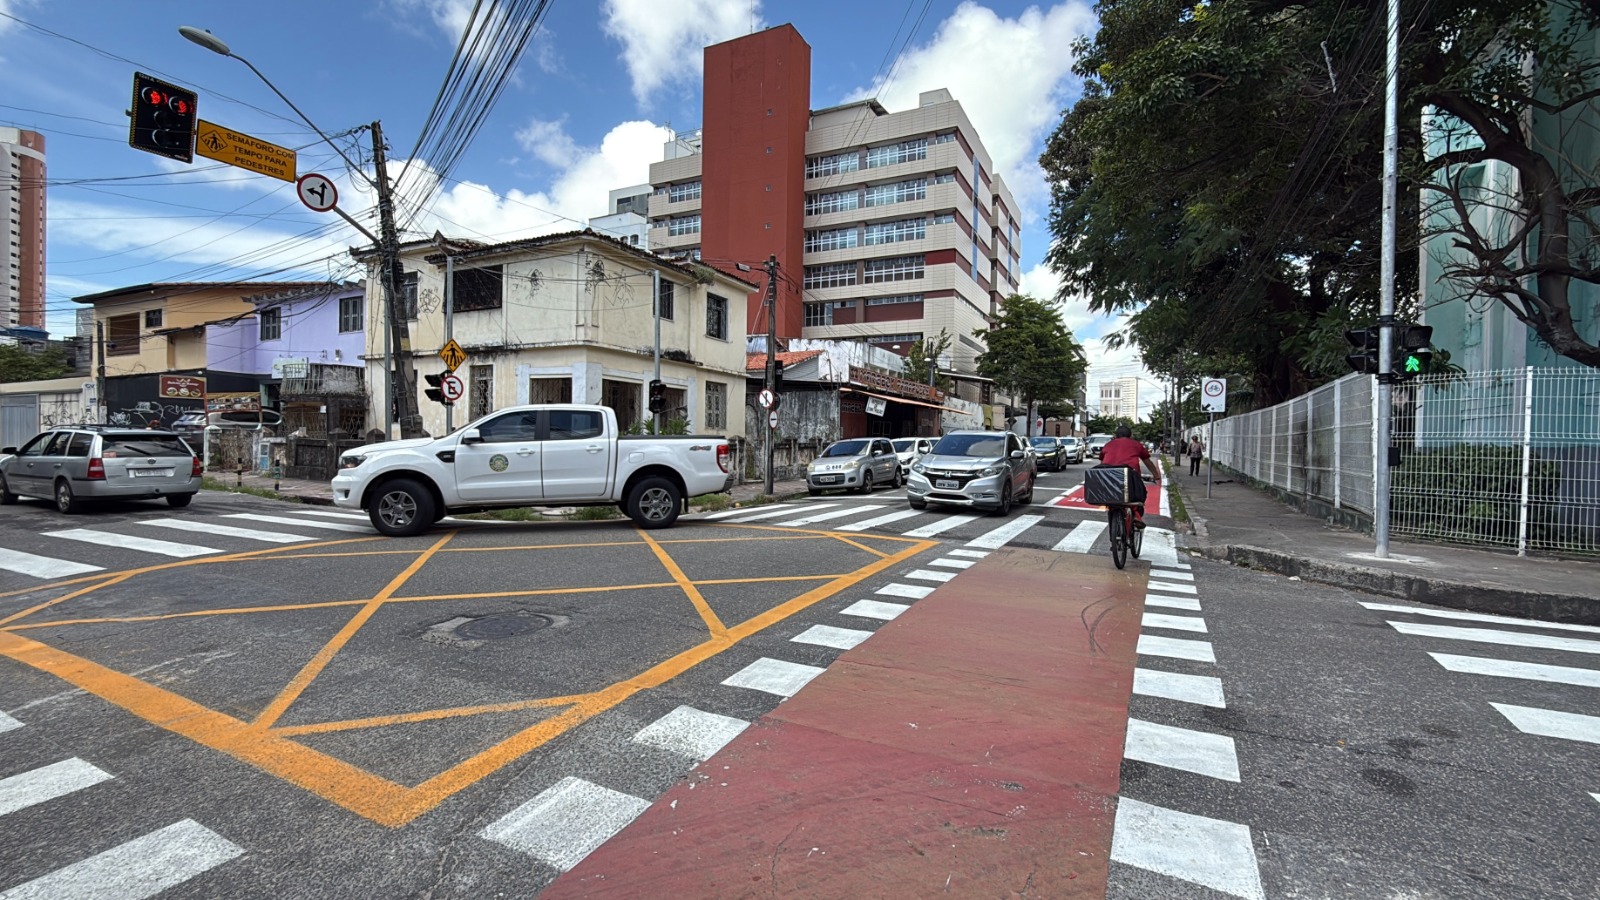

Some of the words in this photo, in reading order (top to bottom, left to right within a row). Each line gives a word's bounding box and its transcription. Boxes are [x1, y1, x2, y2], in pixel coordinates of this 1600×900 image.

[226, 133, 274, 153] SEMÁFORO
[276, 149, 295, 160] COM
[234, 145, 263, 160] TEMPO
[265, 155, 287, 167] PARA
[235, 156, 285, 176] PEDESTRES
[448, 381, 456, 395] E
